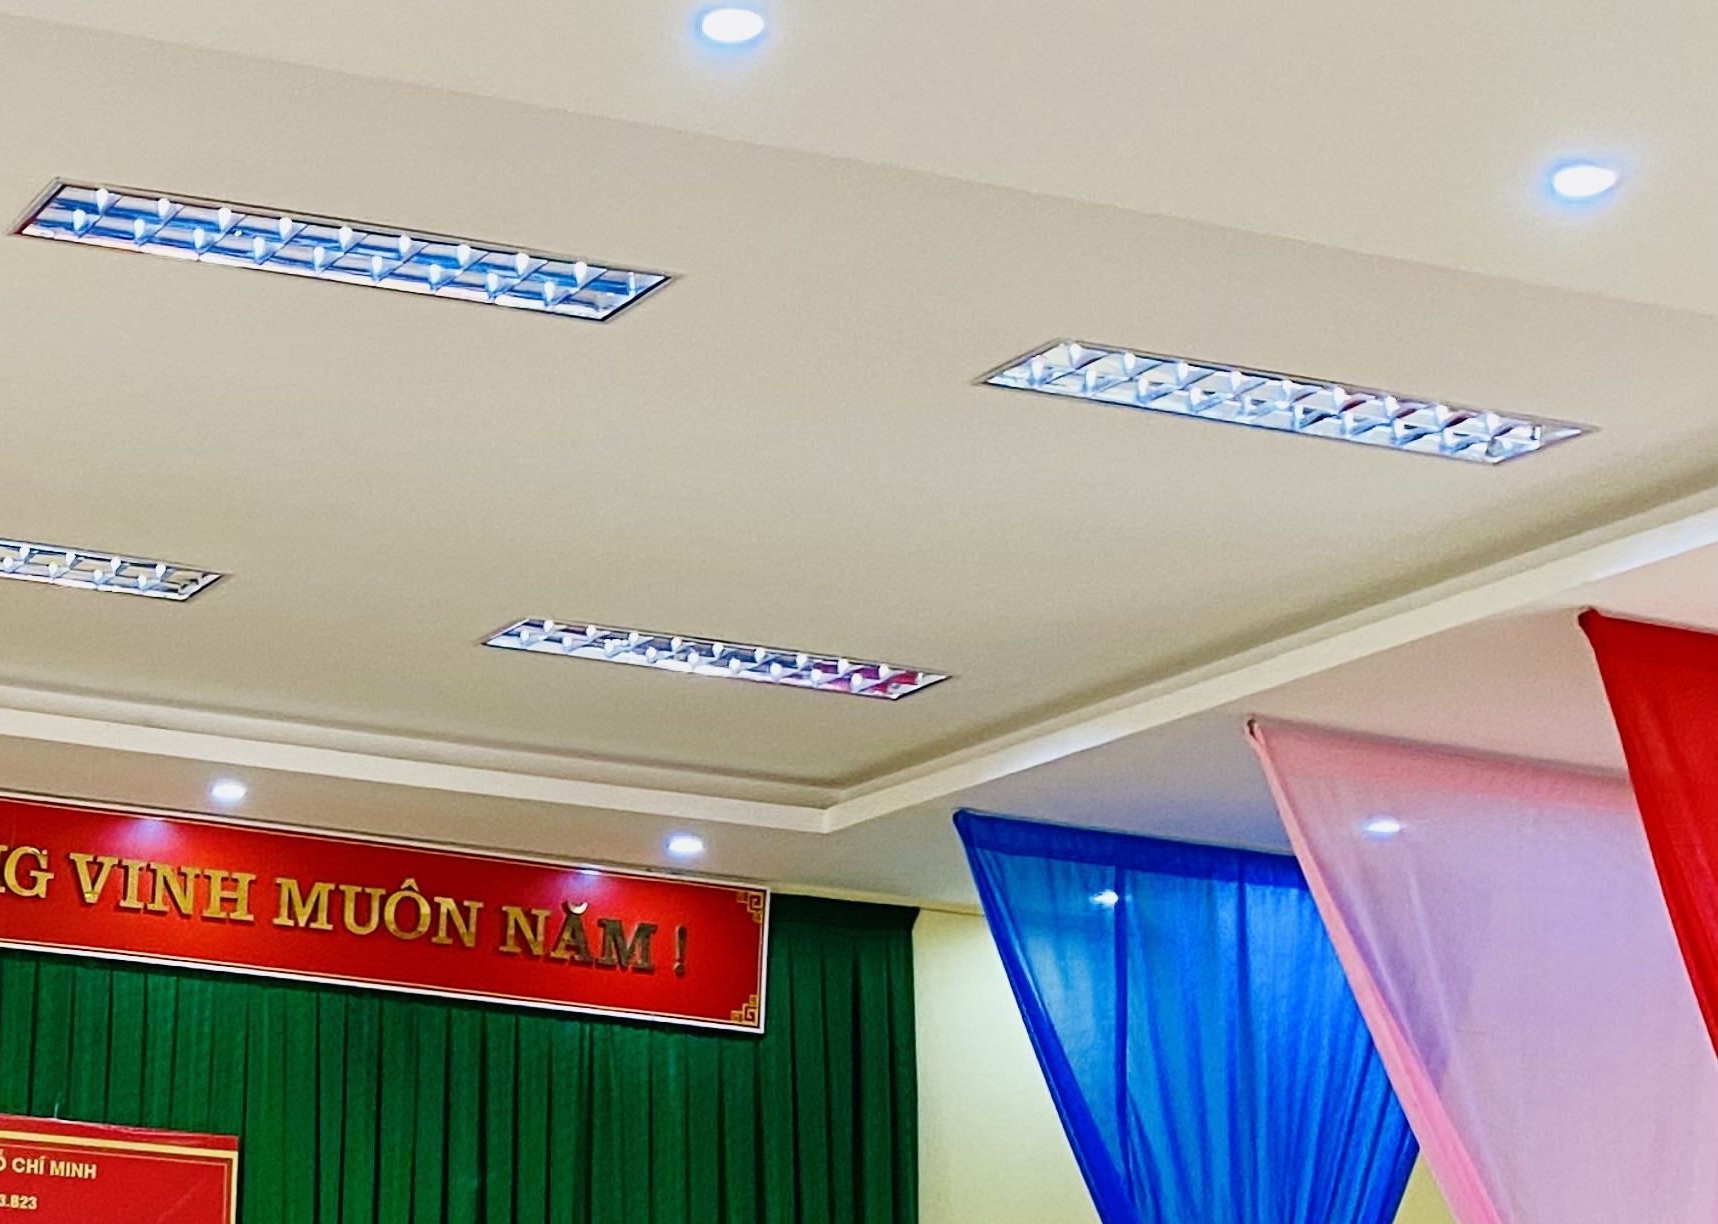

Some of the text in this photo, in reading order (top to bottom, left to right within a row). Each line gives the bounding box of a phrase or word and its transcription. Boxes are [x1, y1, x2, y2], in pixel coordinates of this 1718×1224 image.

[68, 852, 256, 922] VINH
[273, 877, 484, 947] MUÔN
[499, 901, 658, 971] NĂM
[12, 1155, 46, 1175] CHÍ
[49, 1160, 97, 1179] MINH
